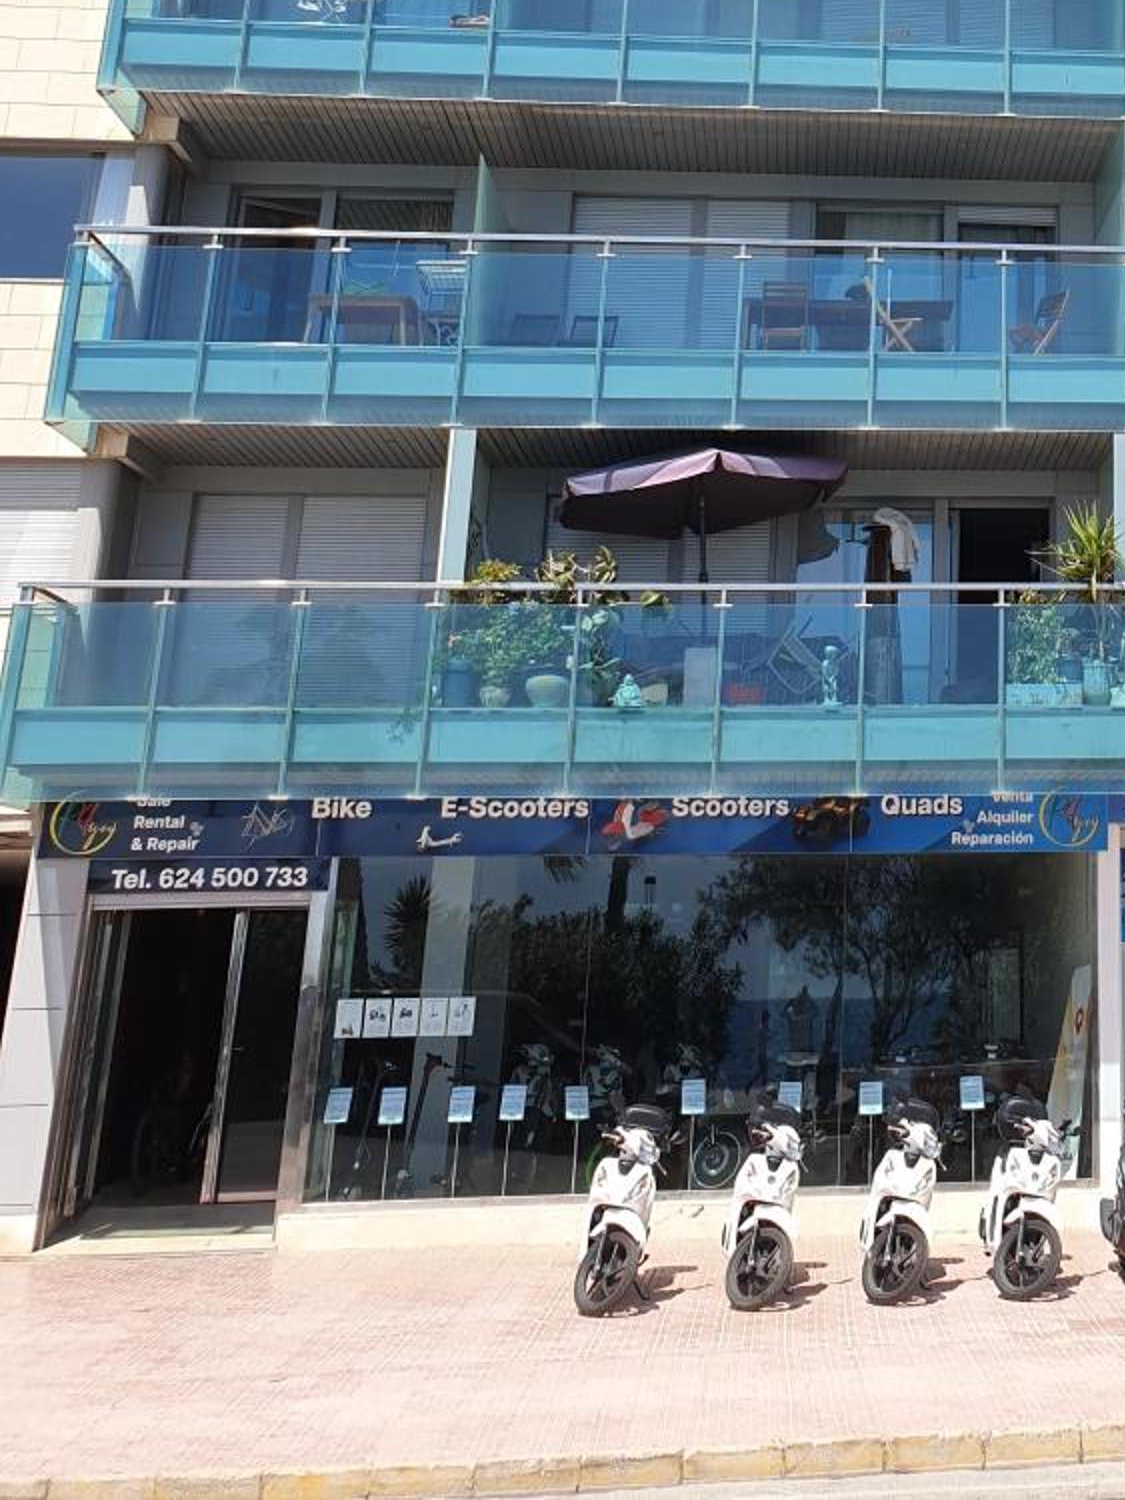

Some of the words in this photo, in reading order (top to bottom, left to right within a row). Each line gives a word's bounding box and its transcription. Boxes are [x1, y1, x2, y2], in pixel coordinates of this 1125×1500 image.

[311, 797, 372, 819] Bike
[441, 797, 589, 818] E-Scooters
[671, 796, 789, 817] Scooters
[880, 794, 963, 815] Quads
[133, 815, 185, 829] Rental
[976, 810, 1034, 825] Alquiler
[130, 837, 143, 851] &
[146, 836, 200, 853] Repair
[951, 830, 1034, 847] Reparación
[111, 869, 151, 889] Tel.
[159, 869, 205, 888] 624
[211, 868, 259, 887] 500
[265, 867, 308, 886] 733
